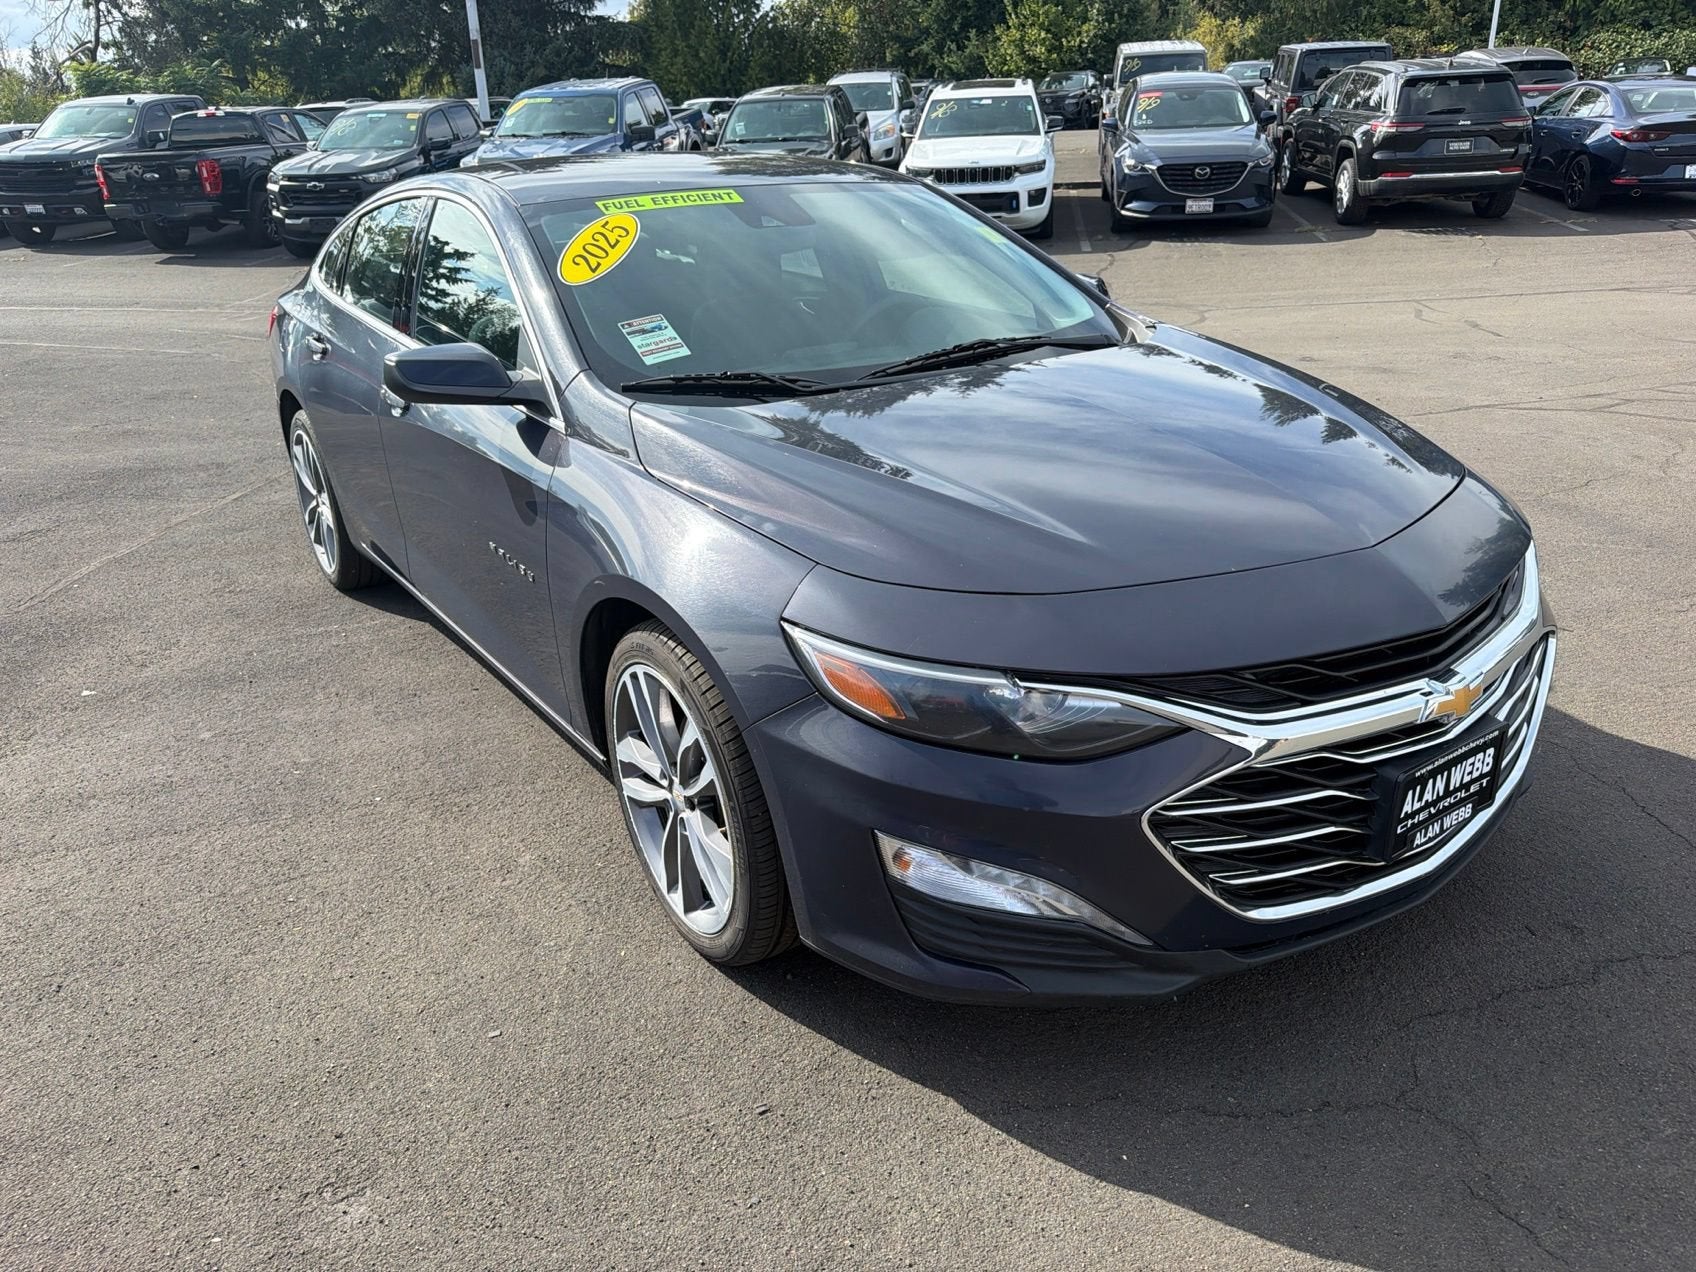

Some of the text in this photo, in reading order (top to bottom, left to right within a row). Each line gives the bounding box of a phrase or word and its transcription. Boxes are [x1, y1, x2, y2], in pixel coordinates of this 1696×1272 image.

[602, 191, 735, 212] FUEL EFFICIENT
[572, 220, 630, 273] 2025
[1396, 777, 1491, 834] CHEVROLET
[1400, 747, 1495, 818] ALAN WEBB
[1413, 803, 1473, 848] ALAN WEBB
